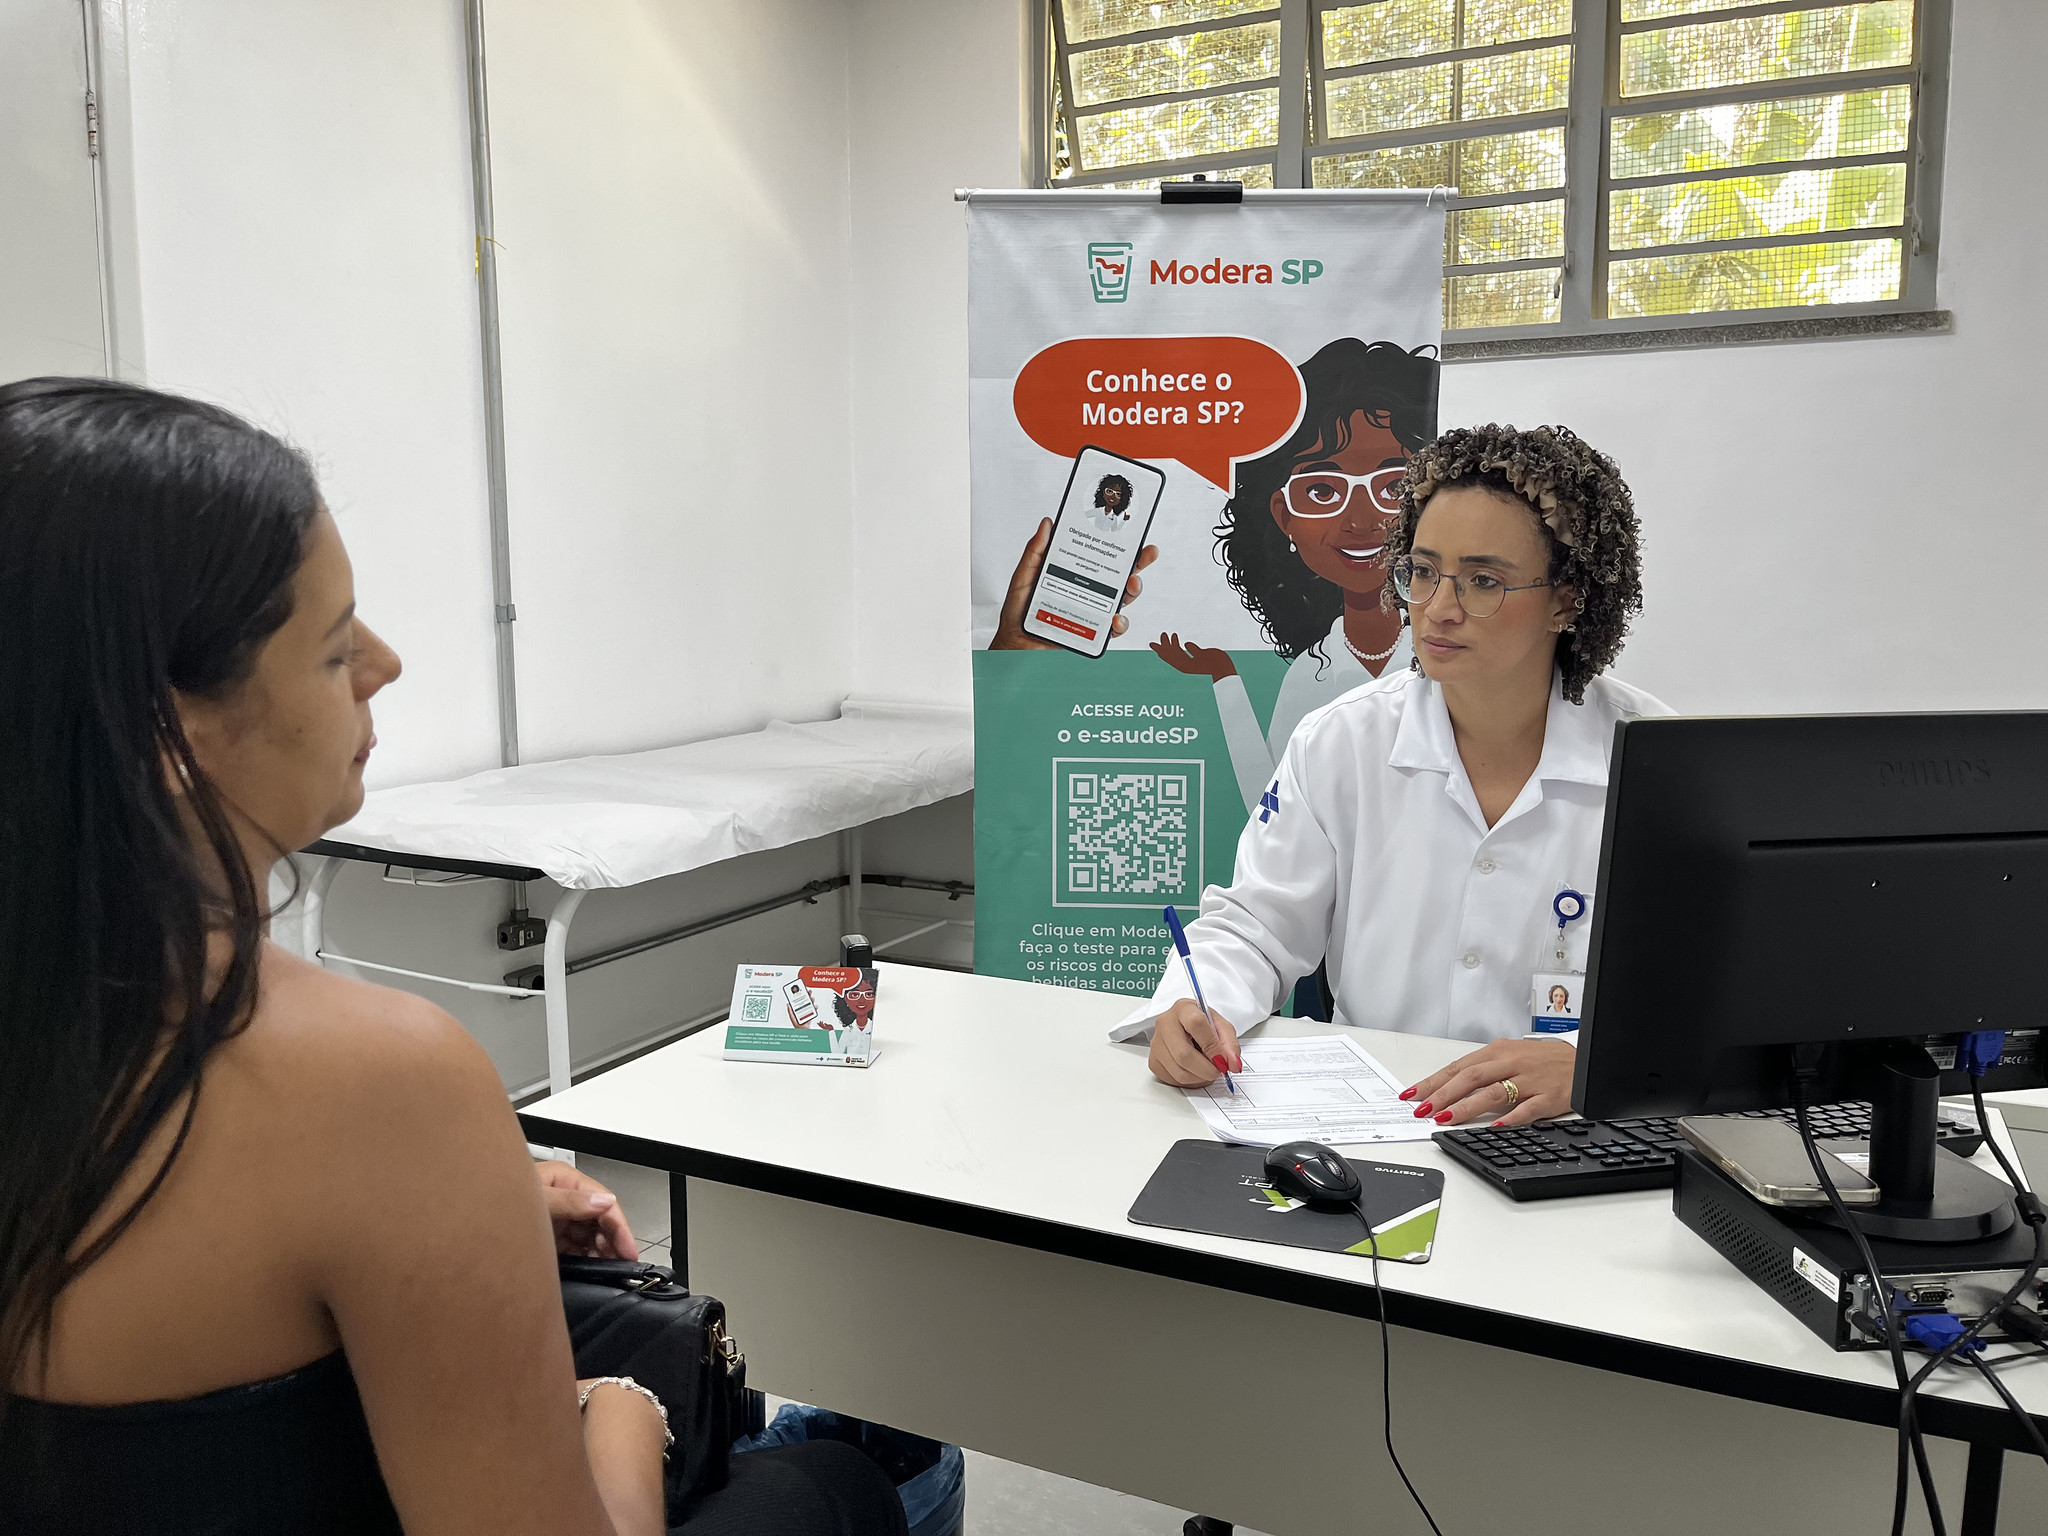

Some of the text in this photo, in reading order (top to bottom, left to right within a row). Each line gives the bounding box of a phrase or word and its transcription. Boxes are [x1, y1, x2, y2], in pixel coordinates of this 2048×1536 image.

[1150, 257, 1324, 285] Modera SP
[1086, 369, 1232, 393] Conhece o
[1082, 400, 1245, 426] Modera SP?
[1071, 704, 1185, 720] ACESSE AQUI:
[1057, 726, 1199, 744] o e-saudeSP
[1032, 923, 1172, 939] Clique em Moder
[1019, 940, 1053, 956] faça
[1058, 943, 1068, 954] o
[1073, 942, 1115, 954] teste
[1120, 945, 1156, 957] para
[1026, 958, 1167, 973] os riscos do cons
[1101, 976, 1160, 991] alcoóli
[1374, 1167, 1425, 1177] POSITIVO
